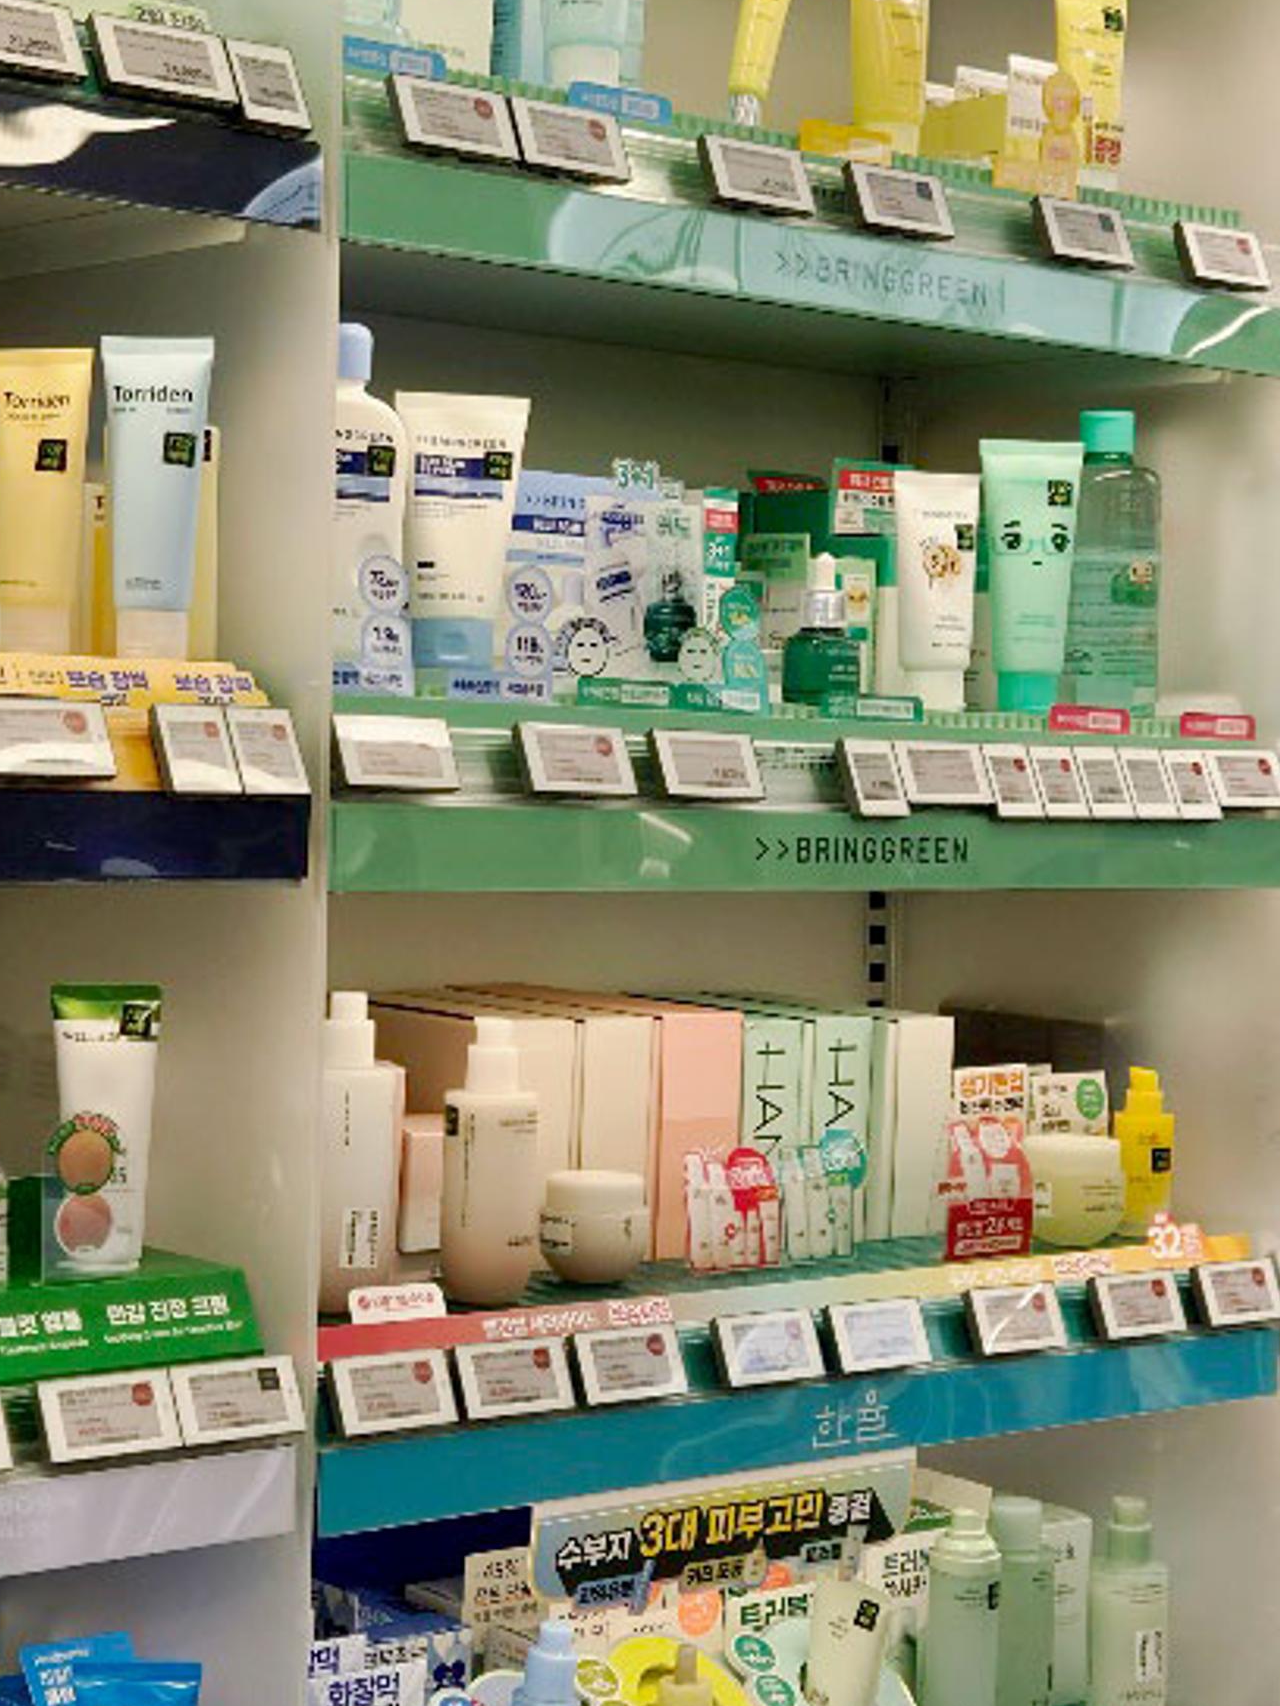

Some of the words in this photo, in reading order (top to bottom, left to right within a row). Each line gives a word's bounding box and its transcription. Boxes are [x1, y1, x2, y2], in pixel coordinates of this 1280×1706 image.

[113, 384, 194, 404] Torriden
[795, 836, 969, 864] BRINGGREEN
[638, 1505, 700, 1558] 3대
